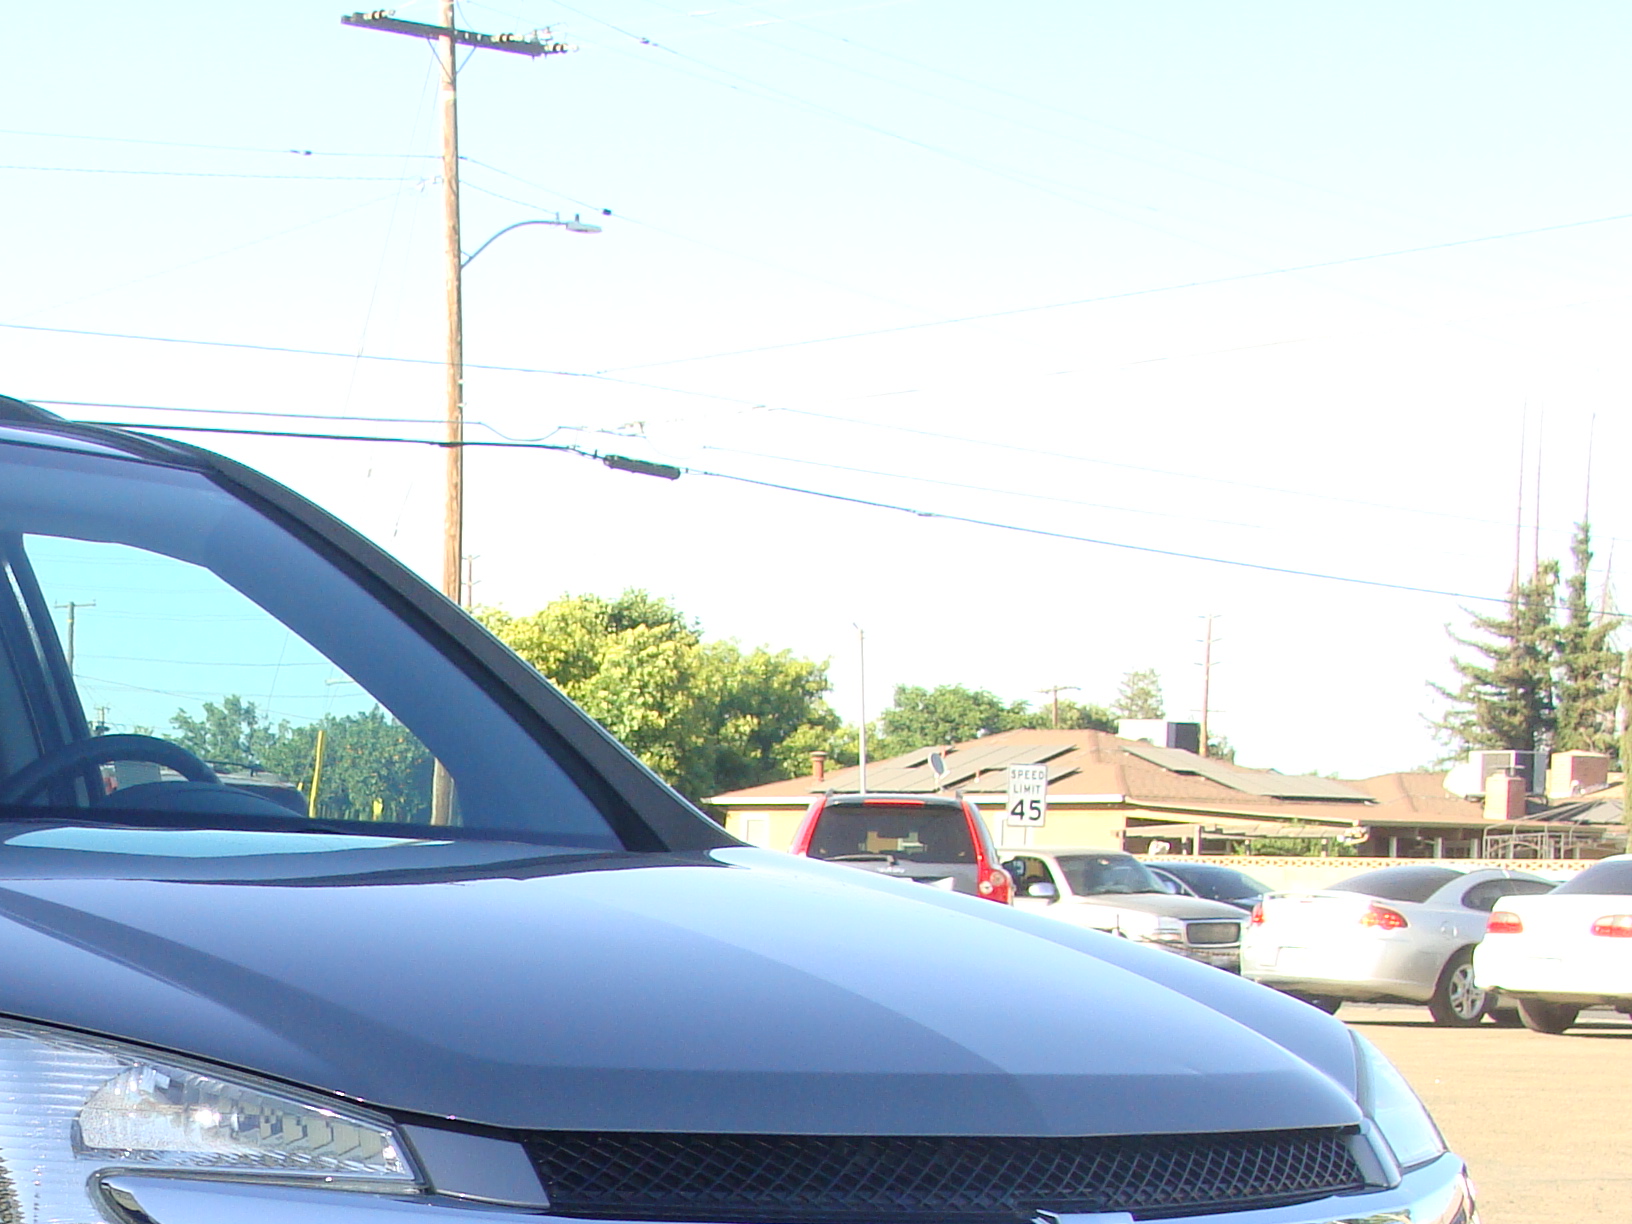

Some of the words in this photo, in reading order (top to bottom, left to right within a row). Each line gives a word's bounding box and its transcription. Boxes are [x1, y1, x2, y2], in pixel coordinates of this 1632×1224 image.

[1011, 769, 1045, 780] SPEED
[1013, 784, 1041, 795] LIMIT
[1010, 799, 1042, 821] 45
